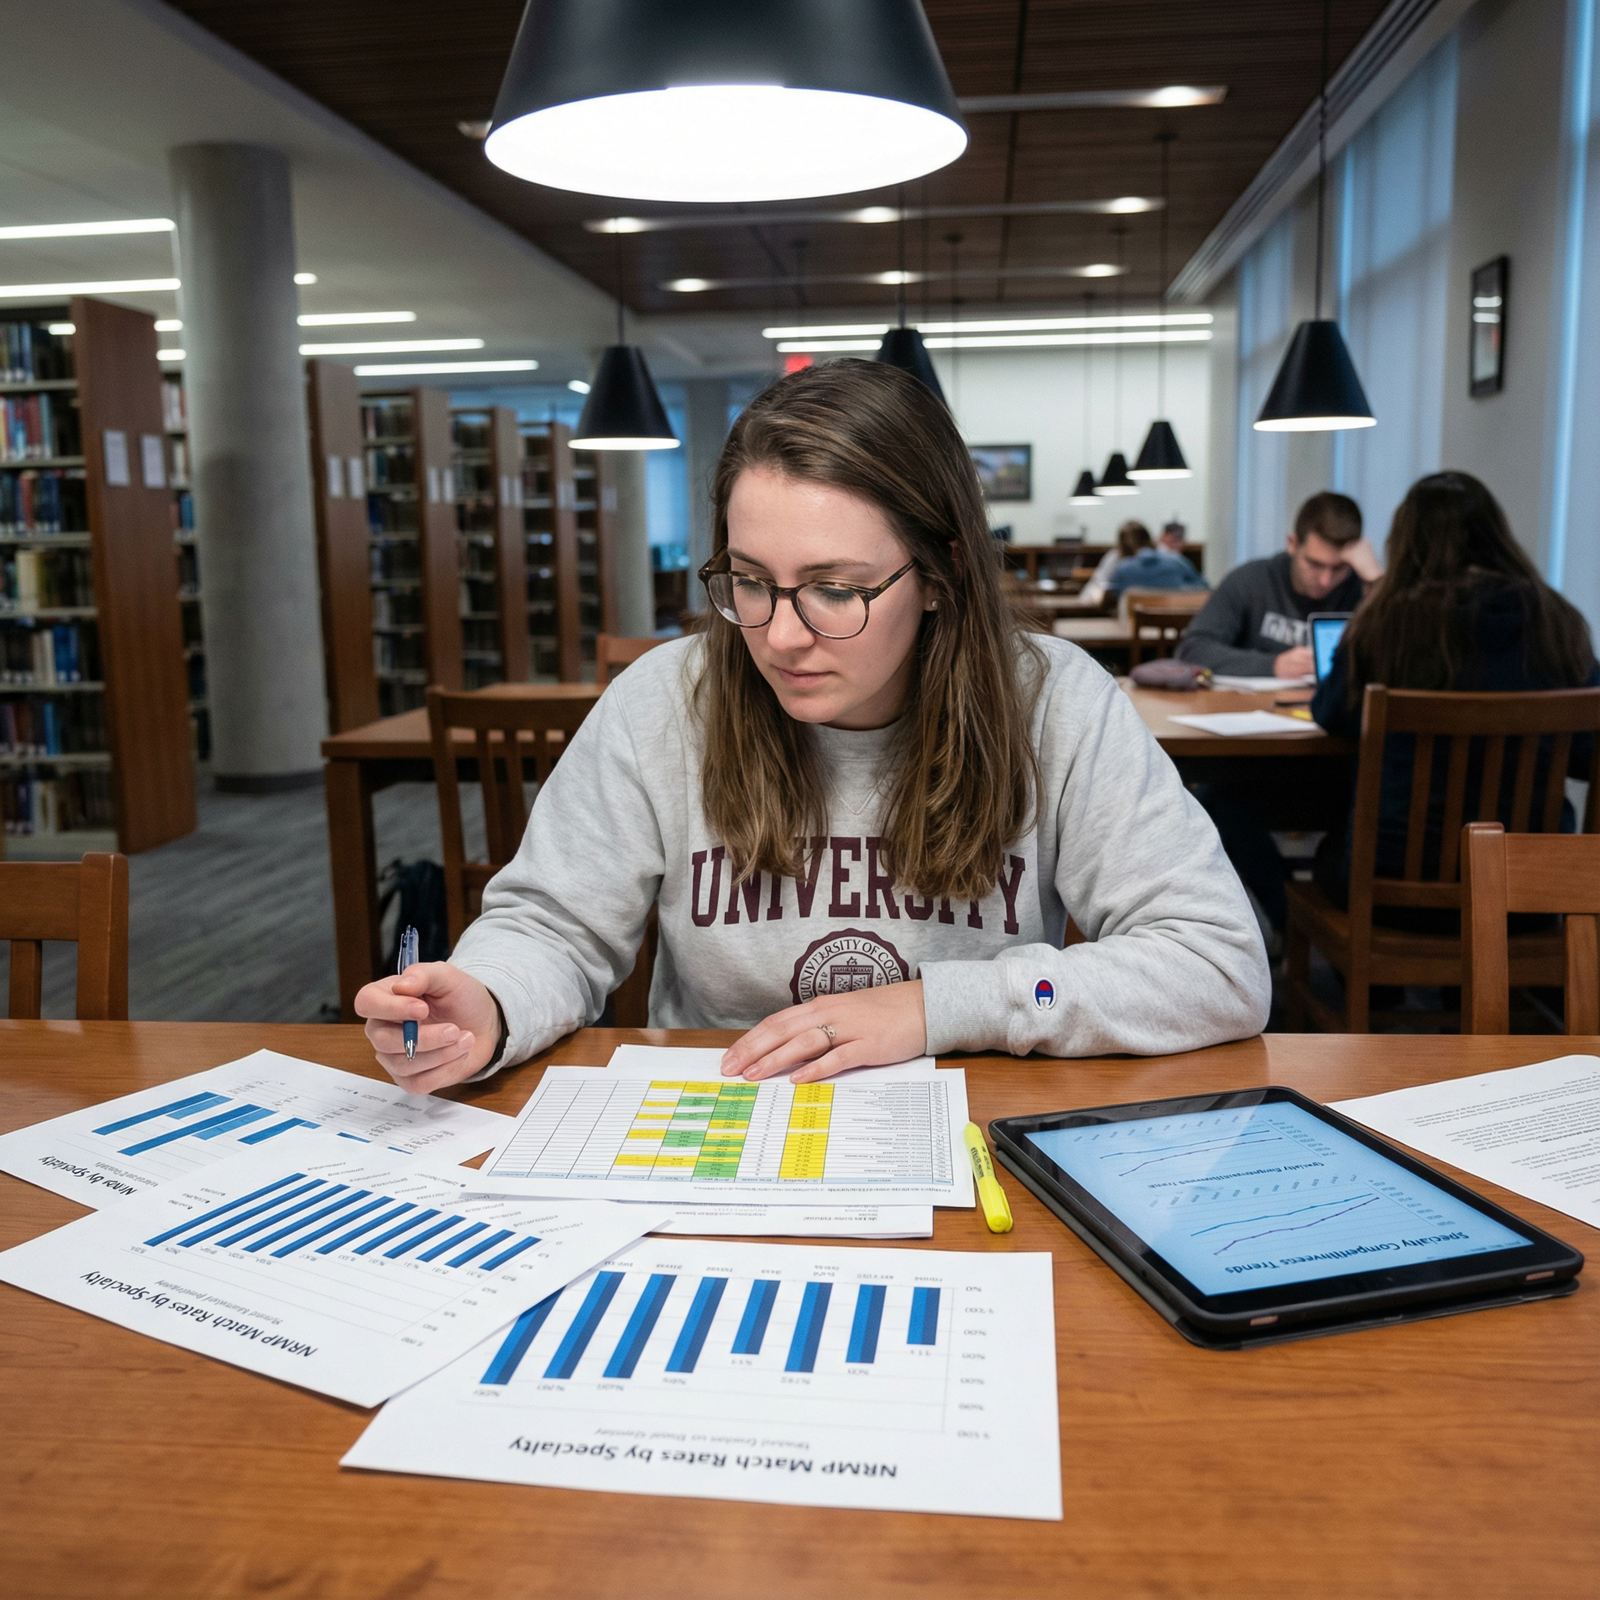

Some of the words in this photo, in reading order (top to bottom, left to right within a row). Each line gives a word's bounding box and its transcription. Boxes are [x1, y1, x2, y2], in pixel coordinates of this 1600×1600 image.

[862, 942, 881, 956] OF
[1225, 1260, 1281, 1274] Trends
[79, 1271, 150, 1301] Specialty
[145, 1292, 170, 1309] by
[168, 1302, 214, 1323] Rates
[213, 1316, 264, 1340] Match
[261, 1334, 319, 1358] NRMP
[508, 1437, 618, 1462] Specialty
[623, 1446, 653, 1464] by
[661, 1450, 727, 1468] Rates
[736, 1455, 813, 1474] Match
[822, 1461, 898, 1479] NRMP
